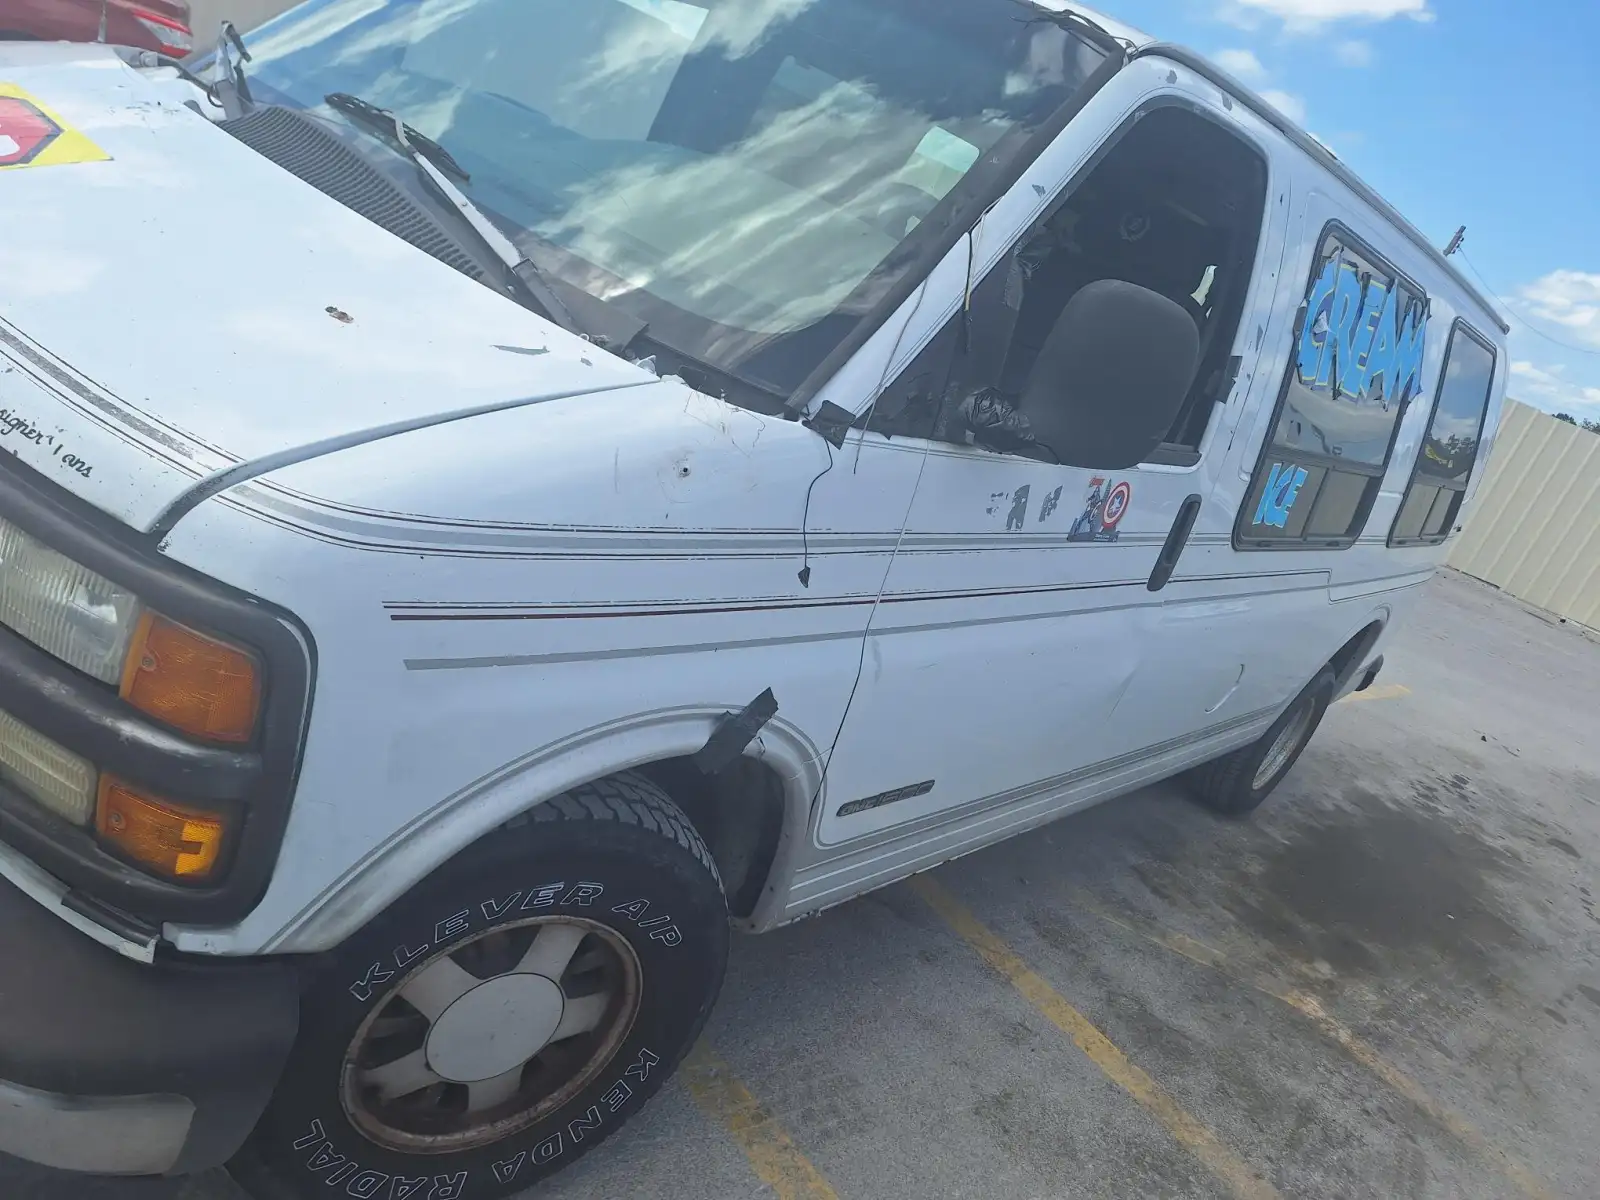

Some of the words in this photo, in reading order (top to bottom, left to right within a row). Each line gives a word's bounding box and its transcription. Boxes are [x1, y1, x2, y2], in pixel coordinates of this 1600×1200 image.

[1297, 257, 1427, 402] CREAM
[1252, 462, 1309, 529] ICE
[348, 881, 604, 1001] KLEVER
[612, 898, 683, 948] A/P
[292, 1118, 468, 1200] RADIAL
[491, 1047, 660, 1184] KENDA
